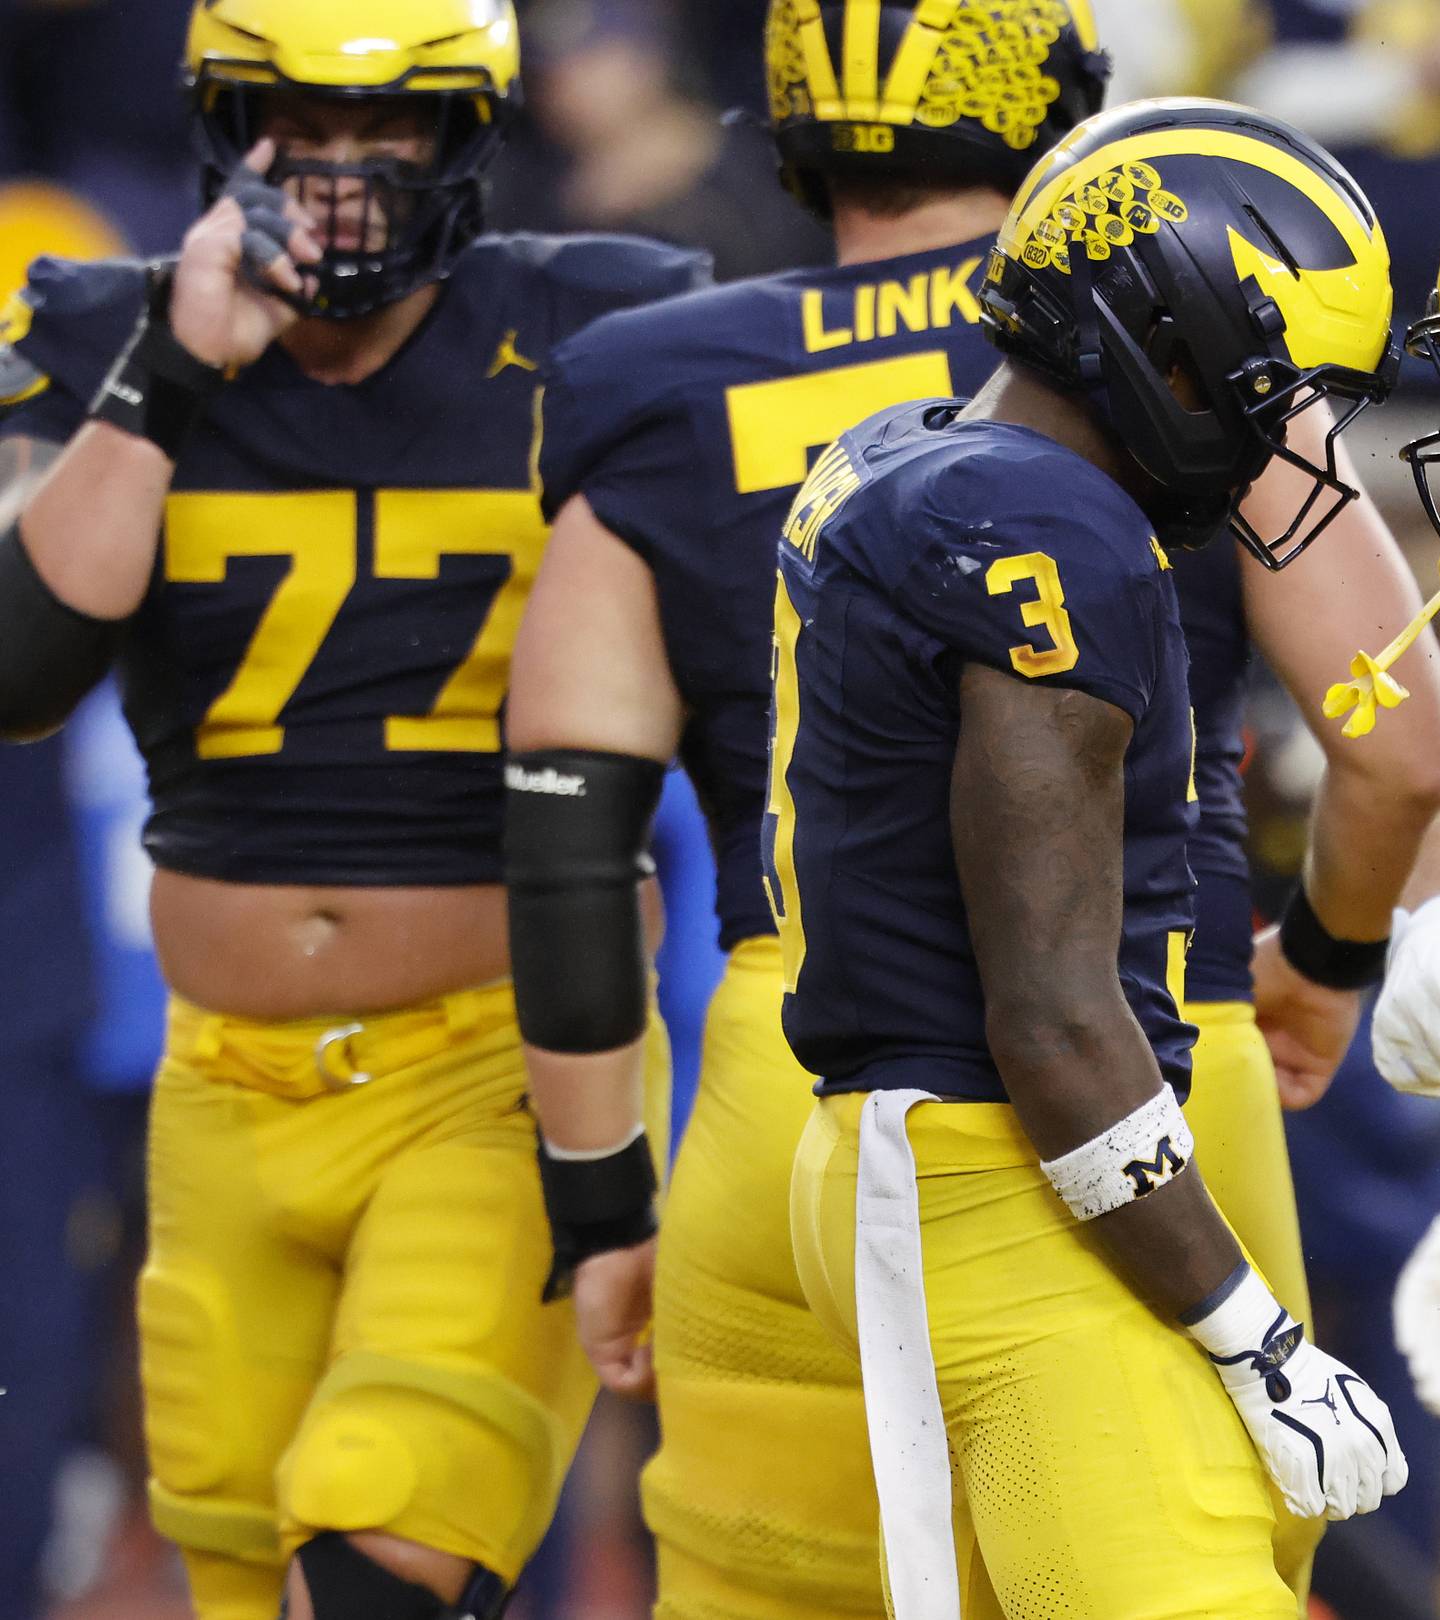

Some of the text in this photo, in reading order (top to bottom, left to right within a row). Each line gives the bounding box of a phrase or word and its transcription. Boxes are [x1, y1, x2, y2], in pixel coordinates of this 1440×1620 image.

[803, 256, 983, 353] LINK
[164, 490, 552, 759] 77
[986, 551, 1080, 678] 3
[1121, 1134, 1186, 1199] M
